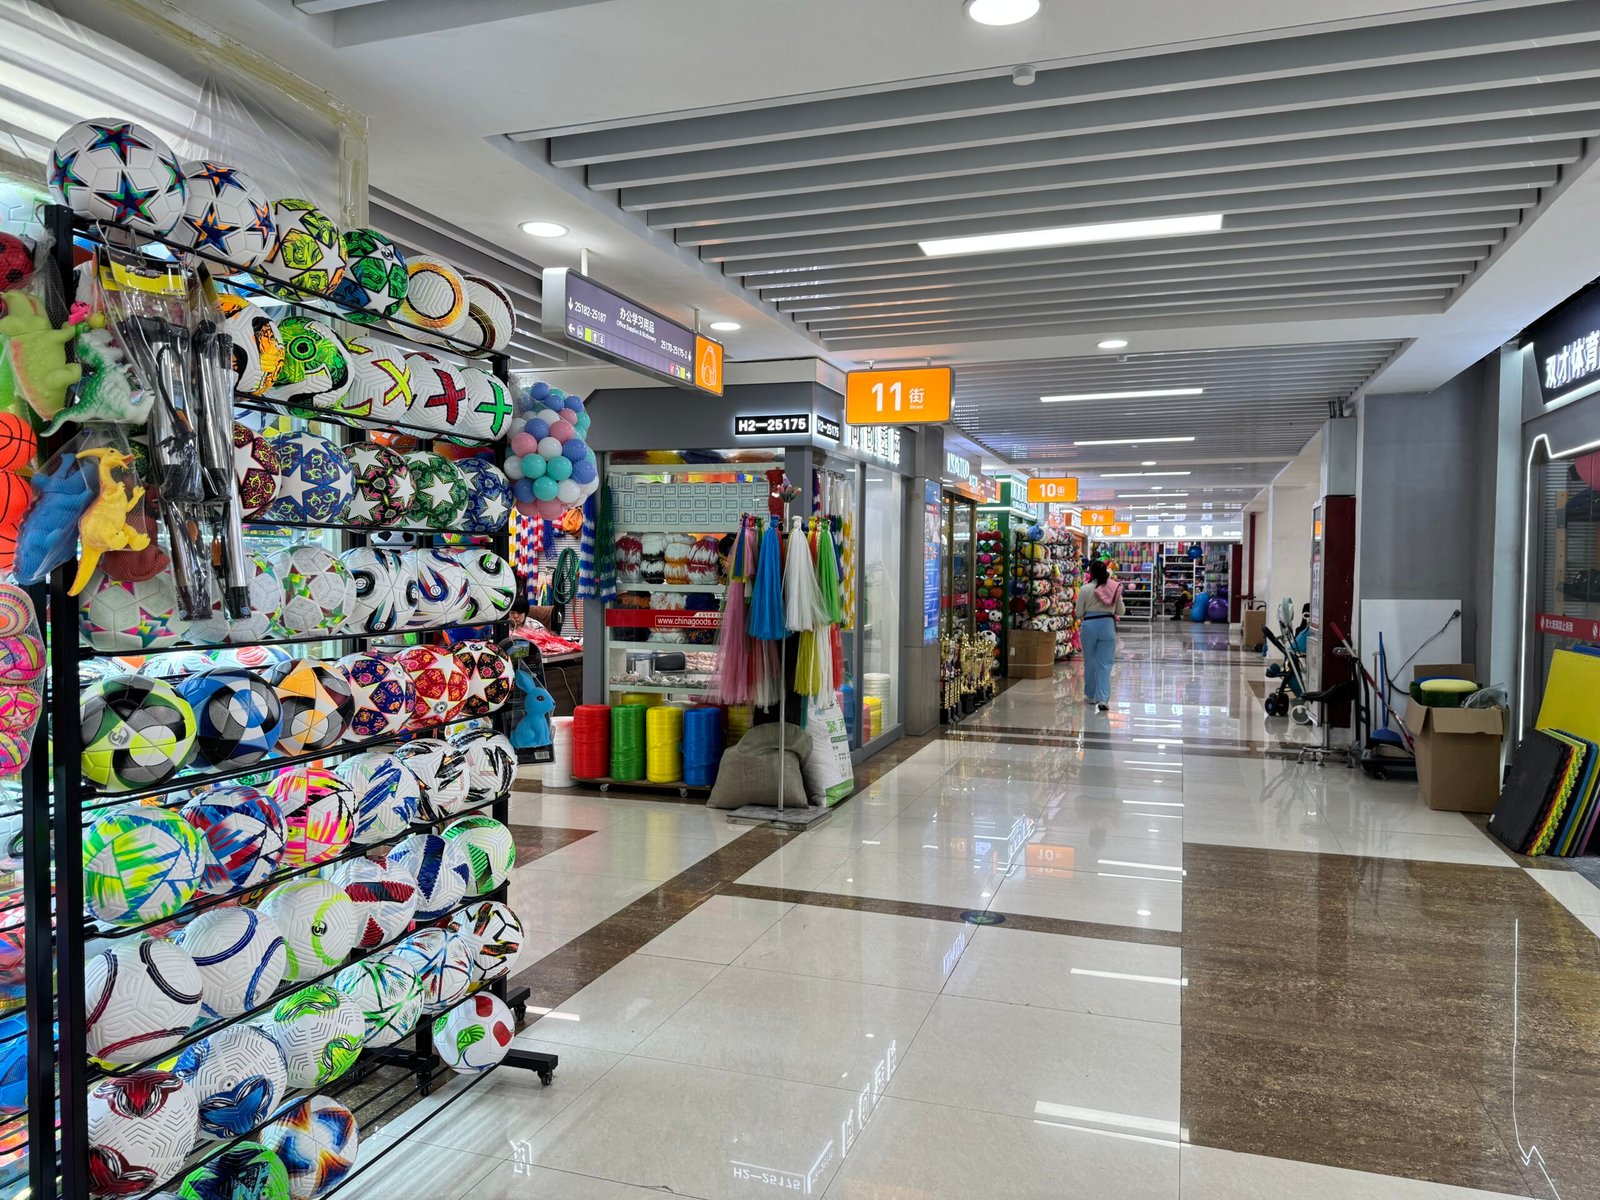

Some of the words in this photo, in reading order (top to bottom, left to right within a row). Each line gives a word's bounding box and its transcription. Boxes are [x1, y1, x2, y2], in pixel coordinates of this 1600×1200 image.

[619, 306, 655, 334] 办公学习用品
[871, 381, 902, 412] 11
[908, 387, 925, 404] 街
[1039, 482, 1056, 498] 10
[1091, 513, 1099, 523] 9
[657, 616, 723, 627] www.chinagoods.co
